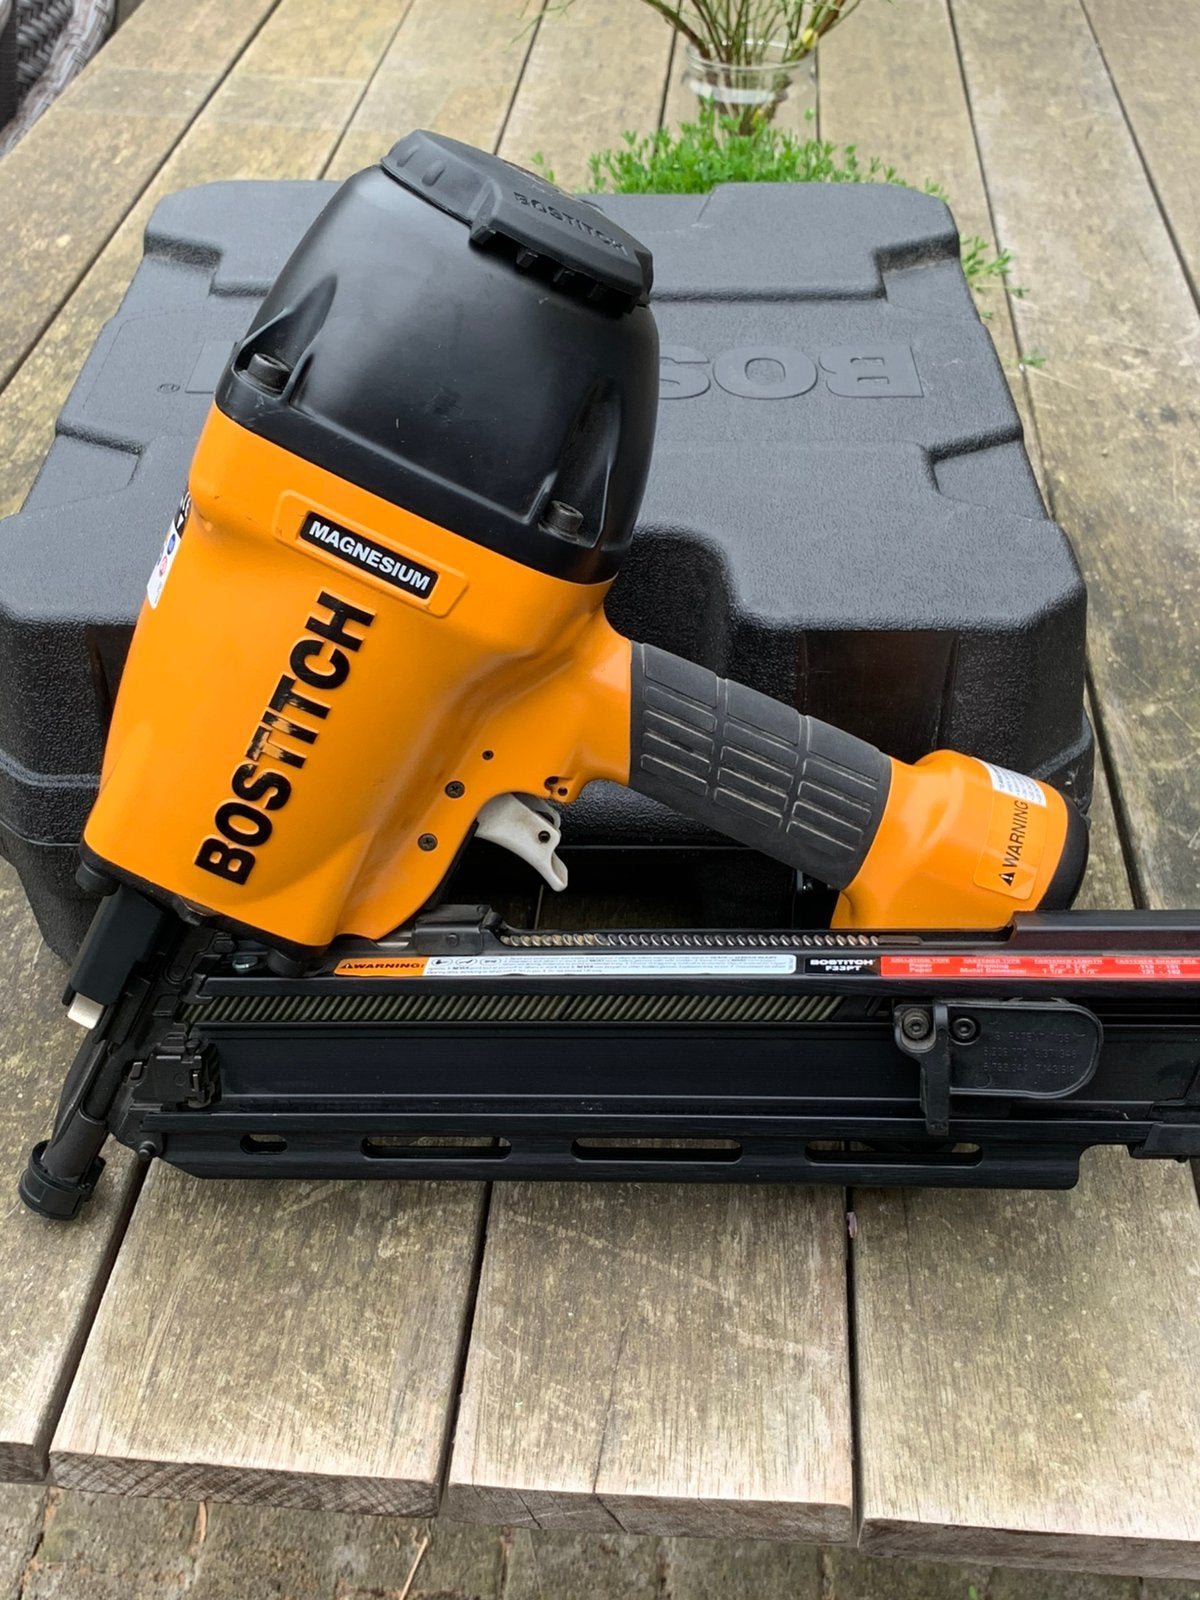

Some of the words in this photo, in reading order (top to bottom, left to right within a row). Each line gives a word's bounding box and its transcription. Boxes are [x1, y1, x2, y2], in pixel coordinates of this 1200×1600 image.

[513, 191, 629, 257] BOSTITCH
[308, 520, 431, 591] MAGNESIUM
[194, 590, 376, 885] BOSTITCH
[1001, 800, 1029, 867] WARNING
